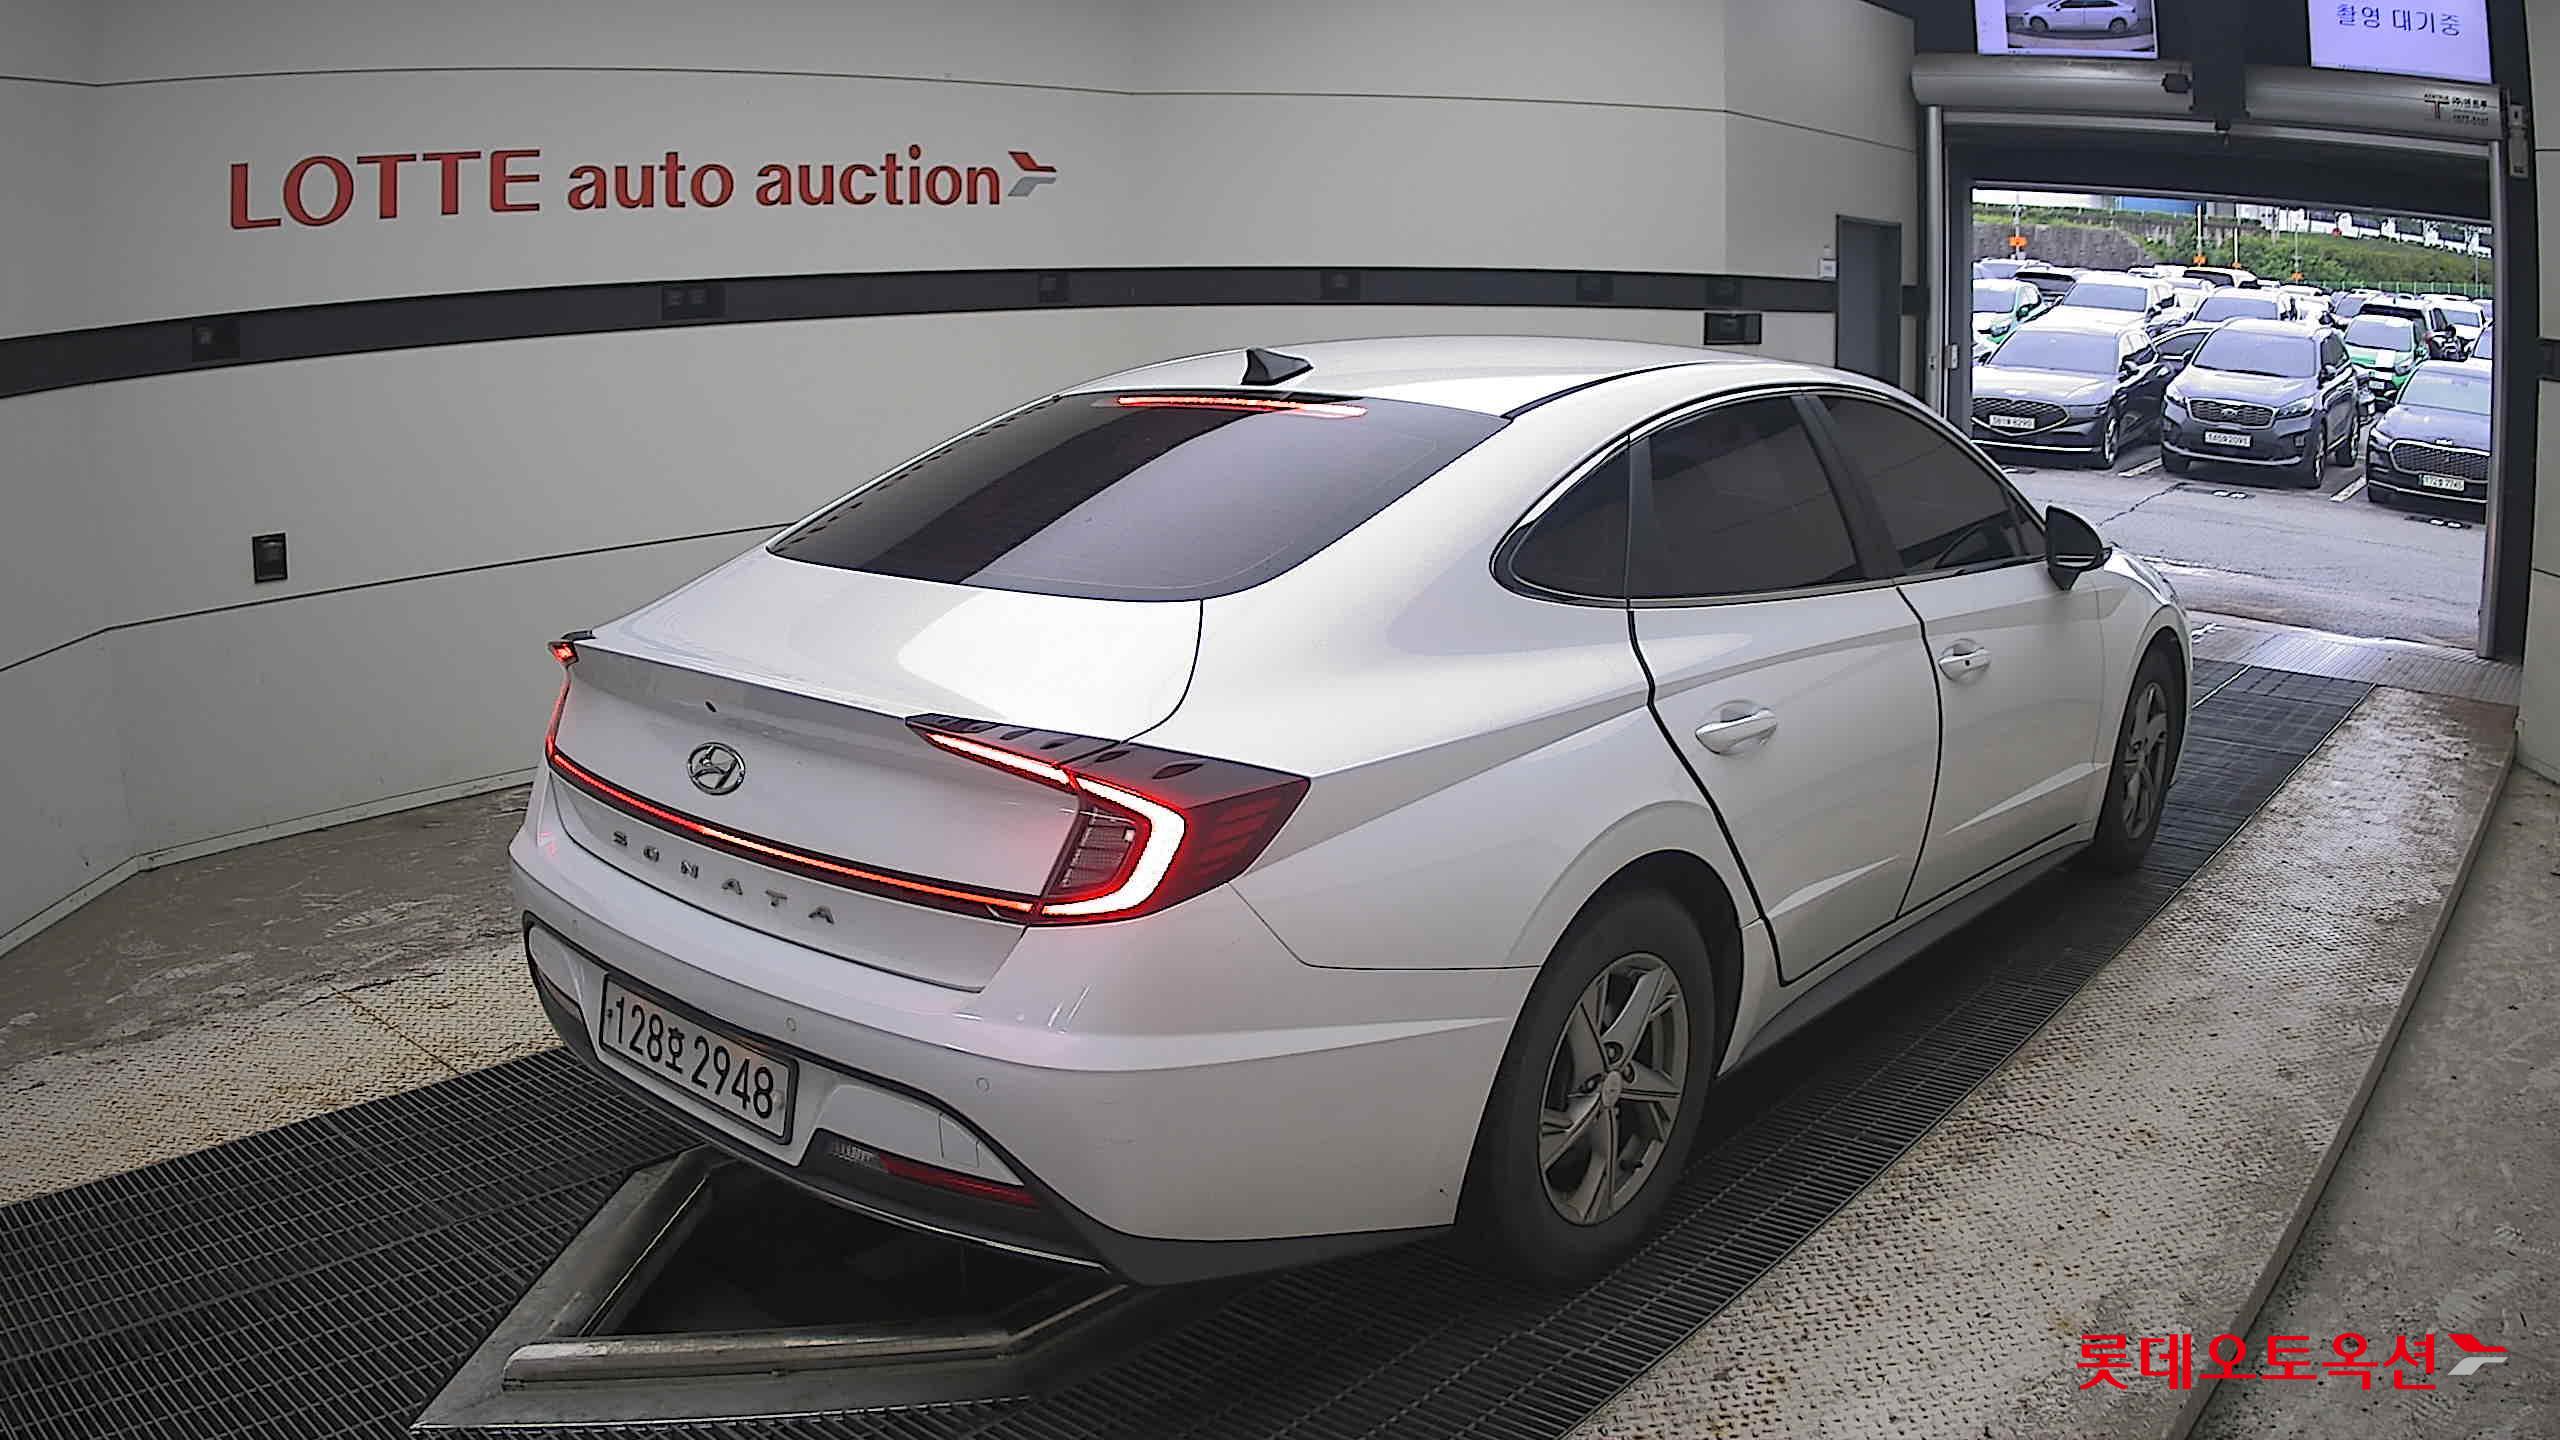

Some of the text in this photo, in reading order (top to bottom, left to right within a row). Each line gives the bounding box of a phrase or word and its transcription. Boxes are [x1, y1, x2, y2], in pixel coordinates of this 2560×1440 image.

[2336, 3, 2462, 37] 촬영 대기중
[230, 144, 1001, 230] LOTTE auto auction
[612, 830, 836, 926] SONATA
[615, 996, 775, 1120] 128호 2948
